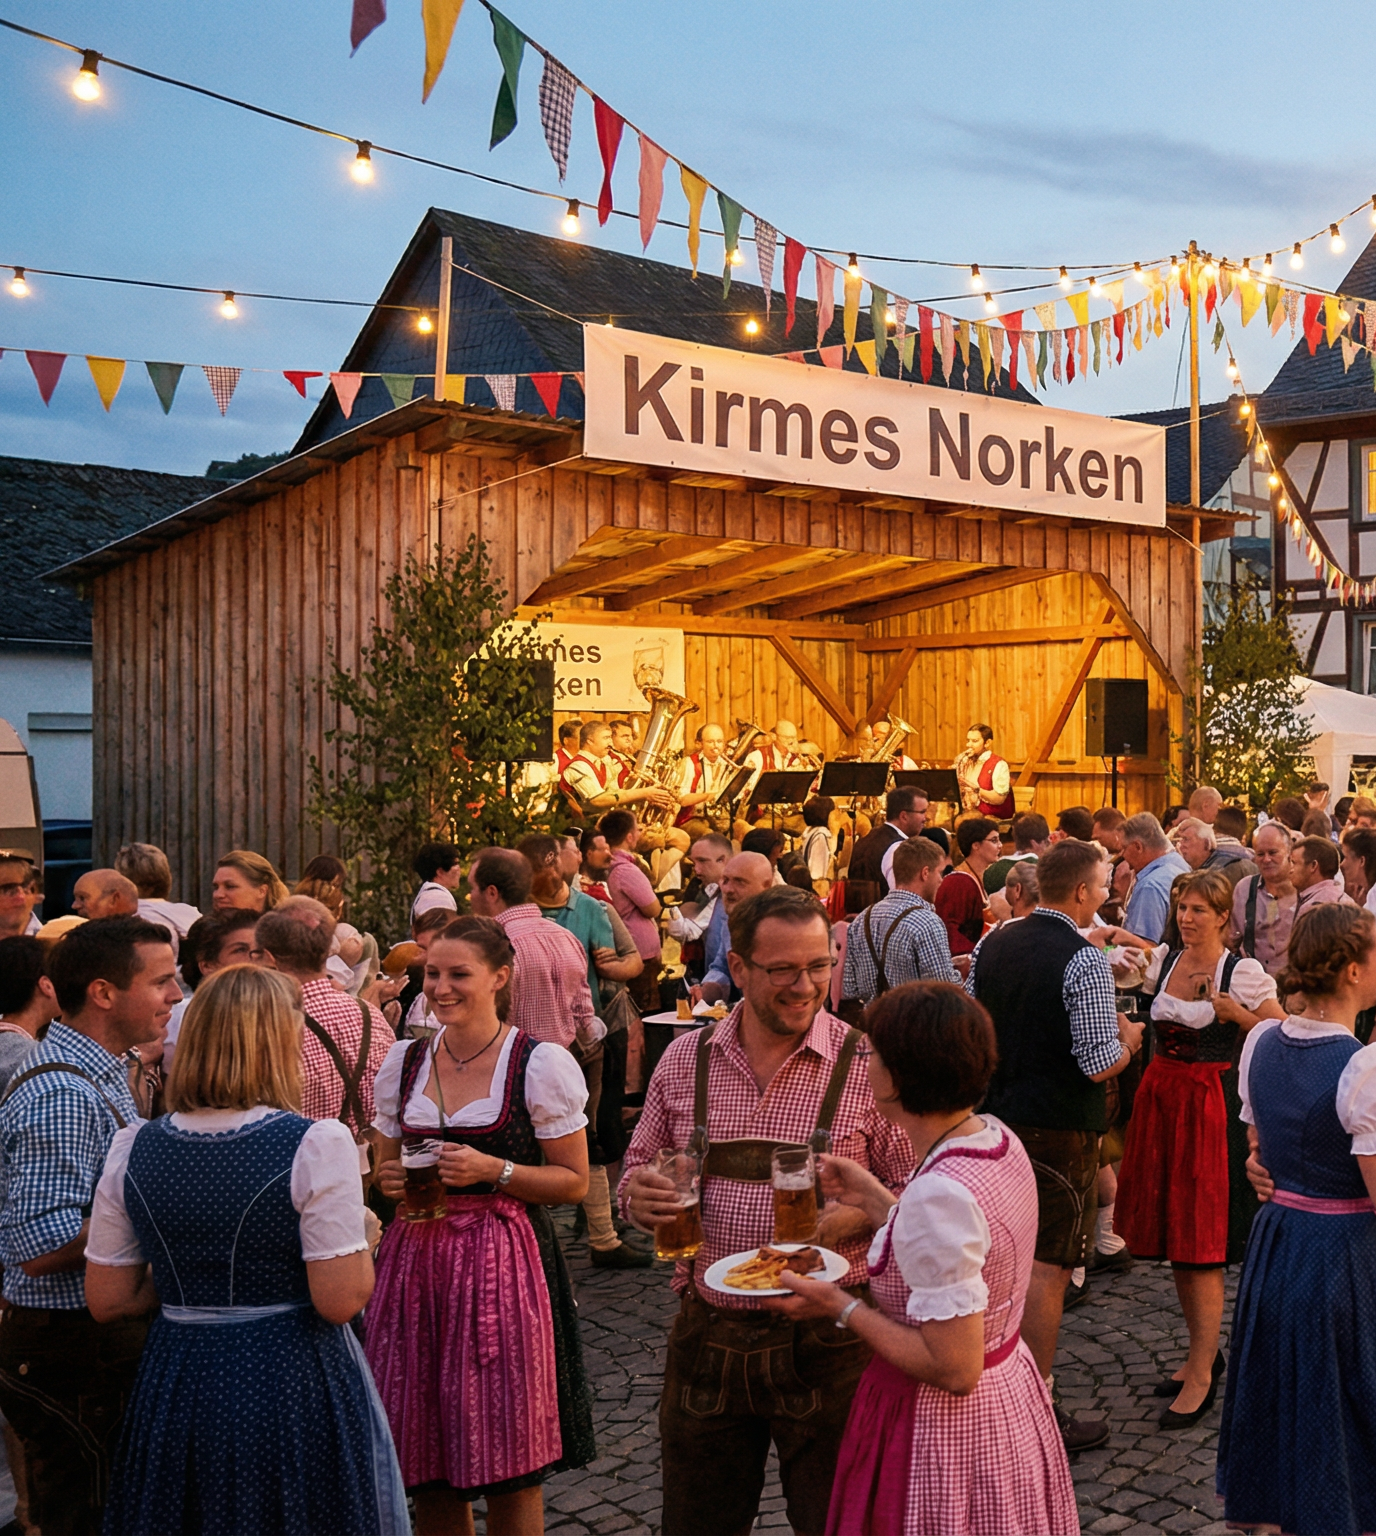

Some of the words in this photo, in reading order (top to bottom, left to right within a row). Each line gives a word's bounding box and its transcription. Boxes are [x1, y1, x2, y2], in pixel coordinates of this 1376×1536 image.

[623, 354, 900, 471] Kirmes
[928, 406, 1144, 504] Norken
[526, 641, 602, 663] mes
[553, 670, 602, 696] ken
